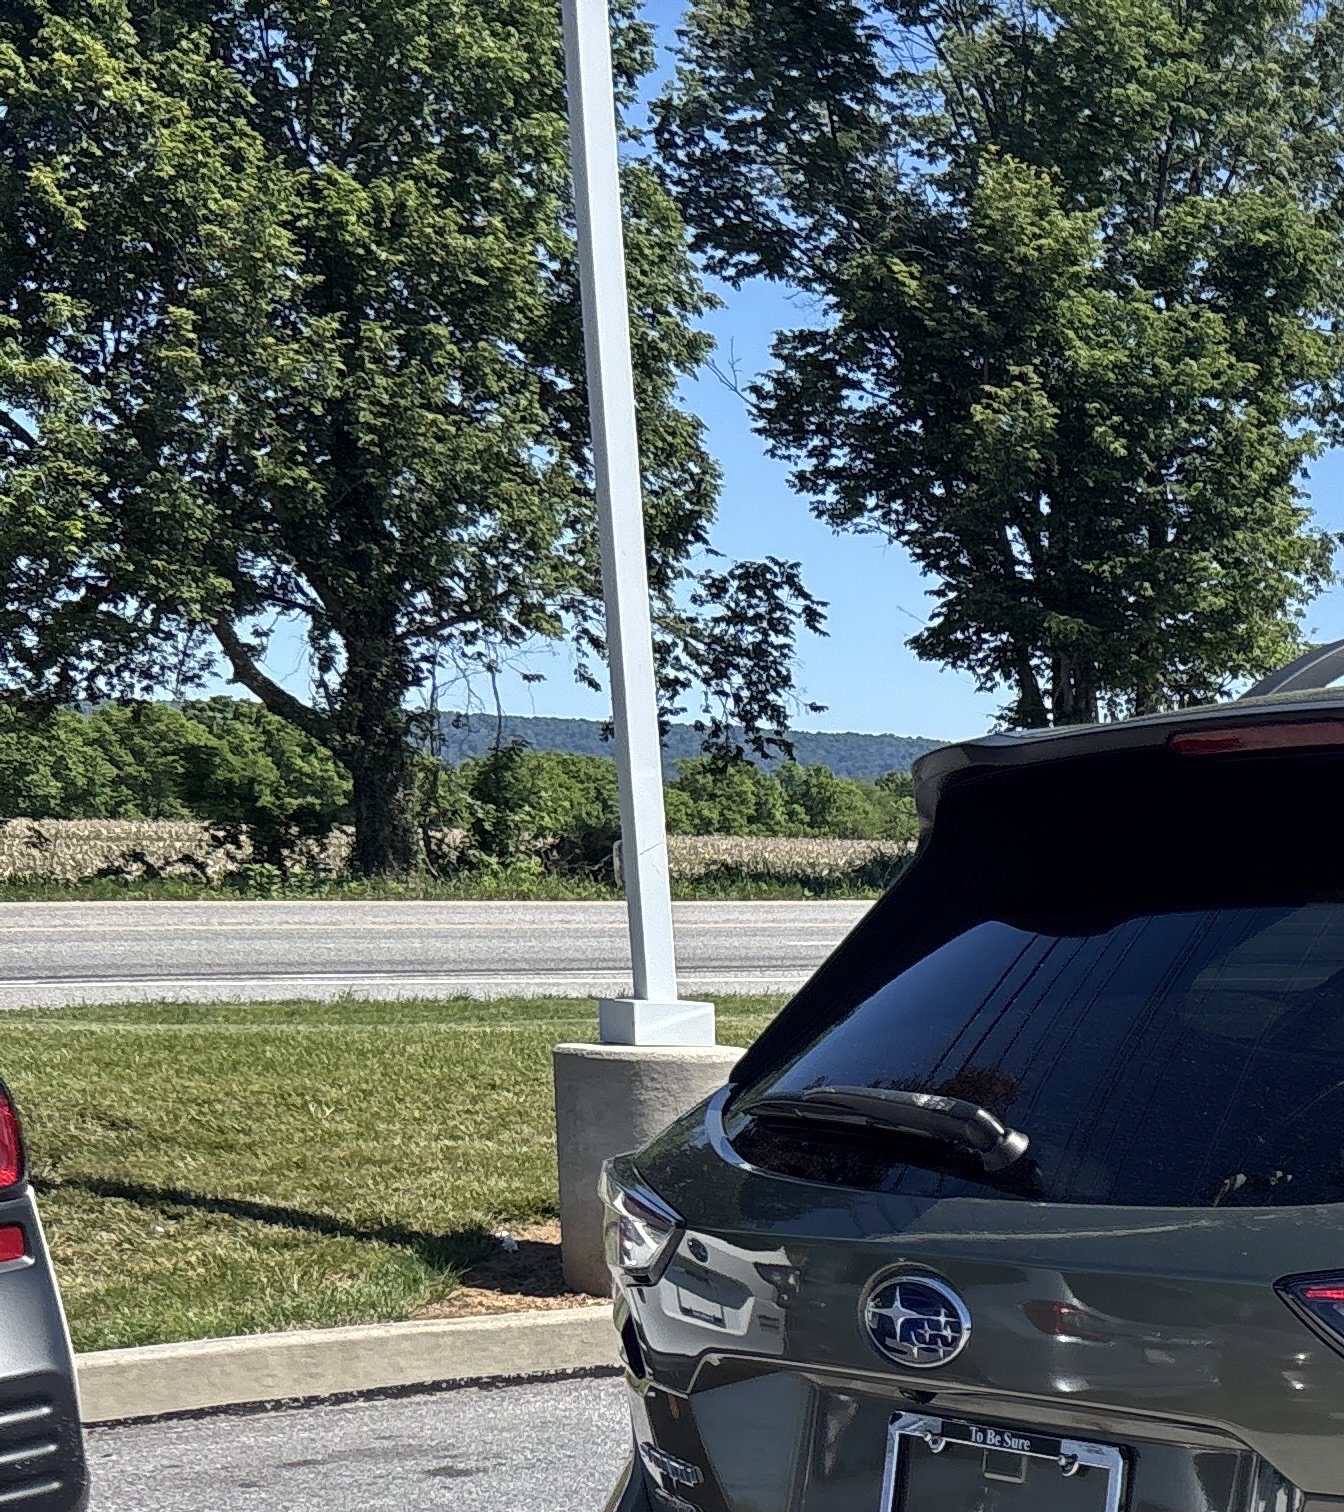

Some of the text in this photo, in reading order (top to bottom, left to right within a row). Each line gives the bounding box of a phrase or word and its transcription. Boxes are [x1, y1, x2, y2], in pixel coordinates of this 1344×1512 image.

[969, 1426, 1031, 1451] To Be Sure
